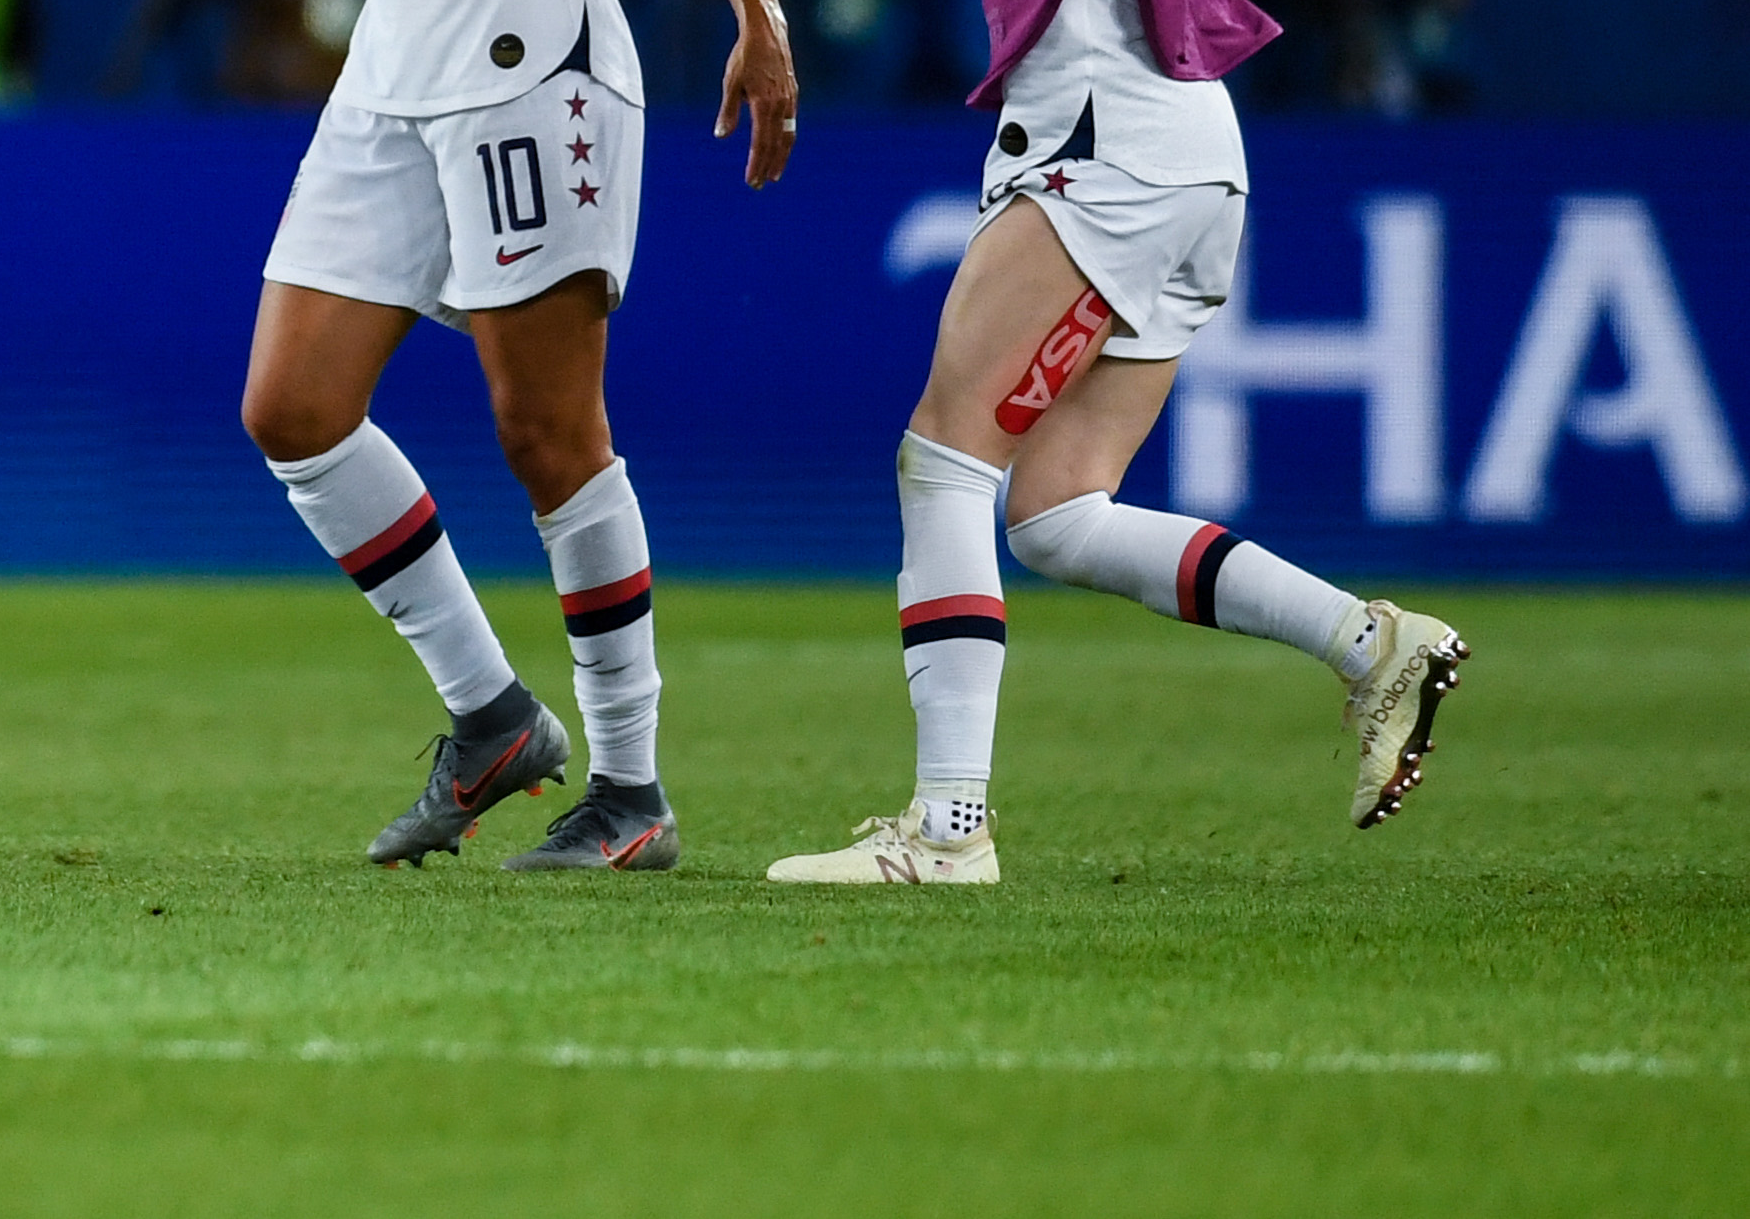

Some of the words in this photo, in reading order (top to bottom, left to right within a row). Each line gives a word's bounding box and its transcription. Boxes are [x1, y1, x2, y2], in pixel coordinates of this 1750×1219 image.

[477, 136, 547, 235] 10
[882, 191, 1749, 523] HA
[1007, 289, 1105, 400] USA
[1367, 643, 1431, 725] balance
